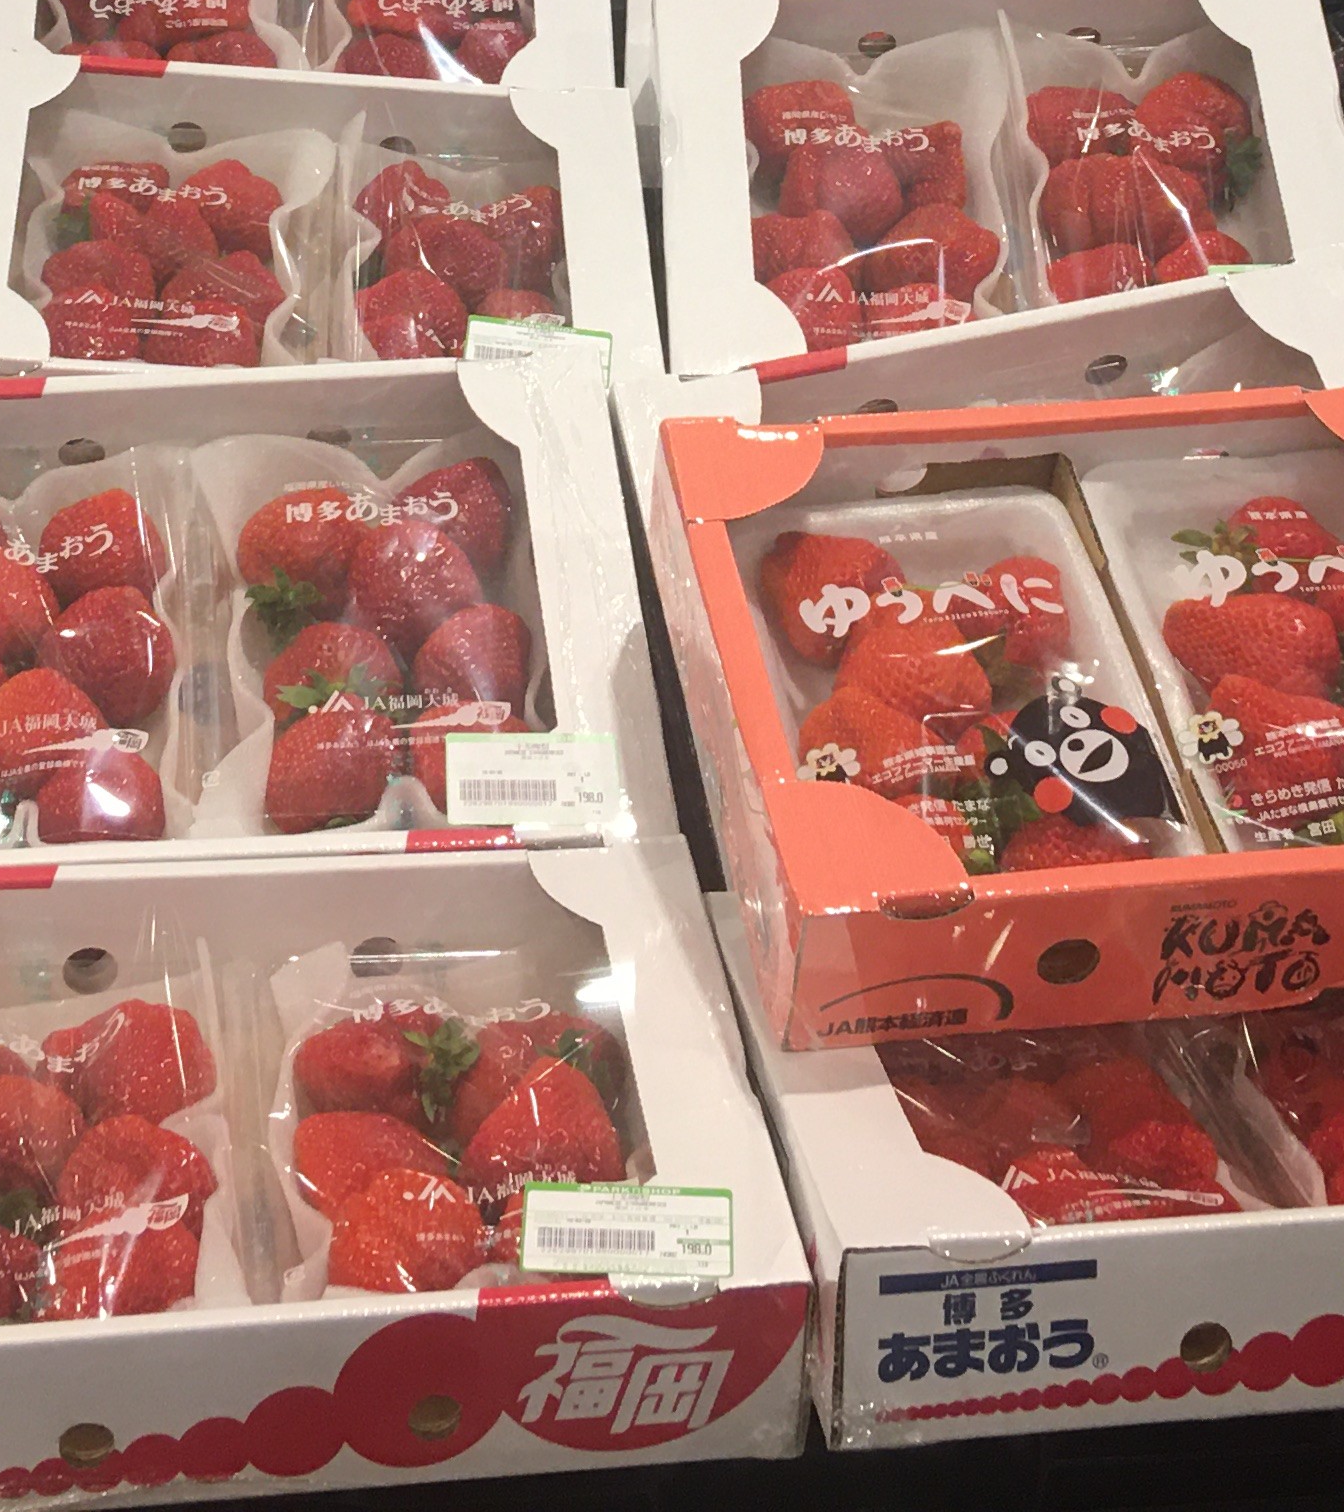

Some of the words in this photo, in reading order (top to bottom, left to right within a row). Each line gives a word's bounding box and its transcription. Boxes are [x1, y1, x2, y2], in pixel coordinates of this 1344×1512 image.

[943, 1289, 1034, 1327] 博多
[516, 1316, 735, 1435] 福岡
[877, 1319, 1095, 1383] あまおう
